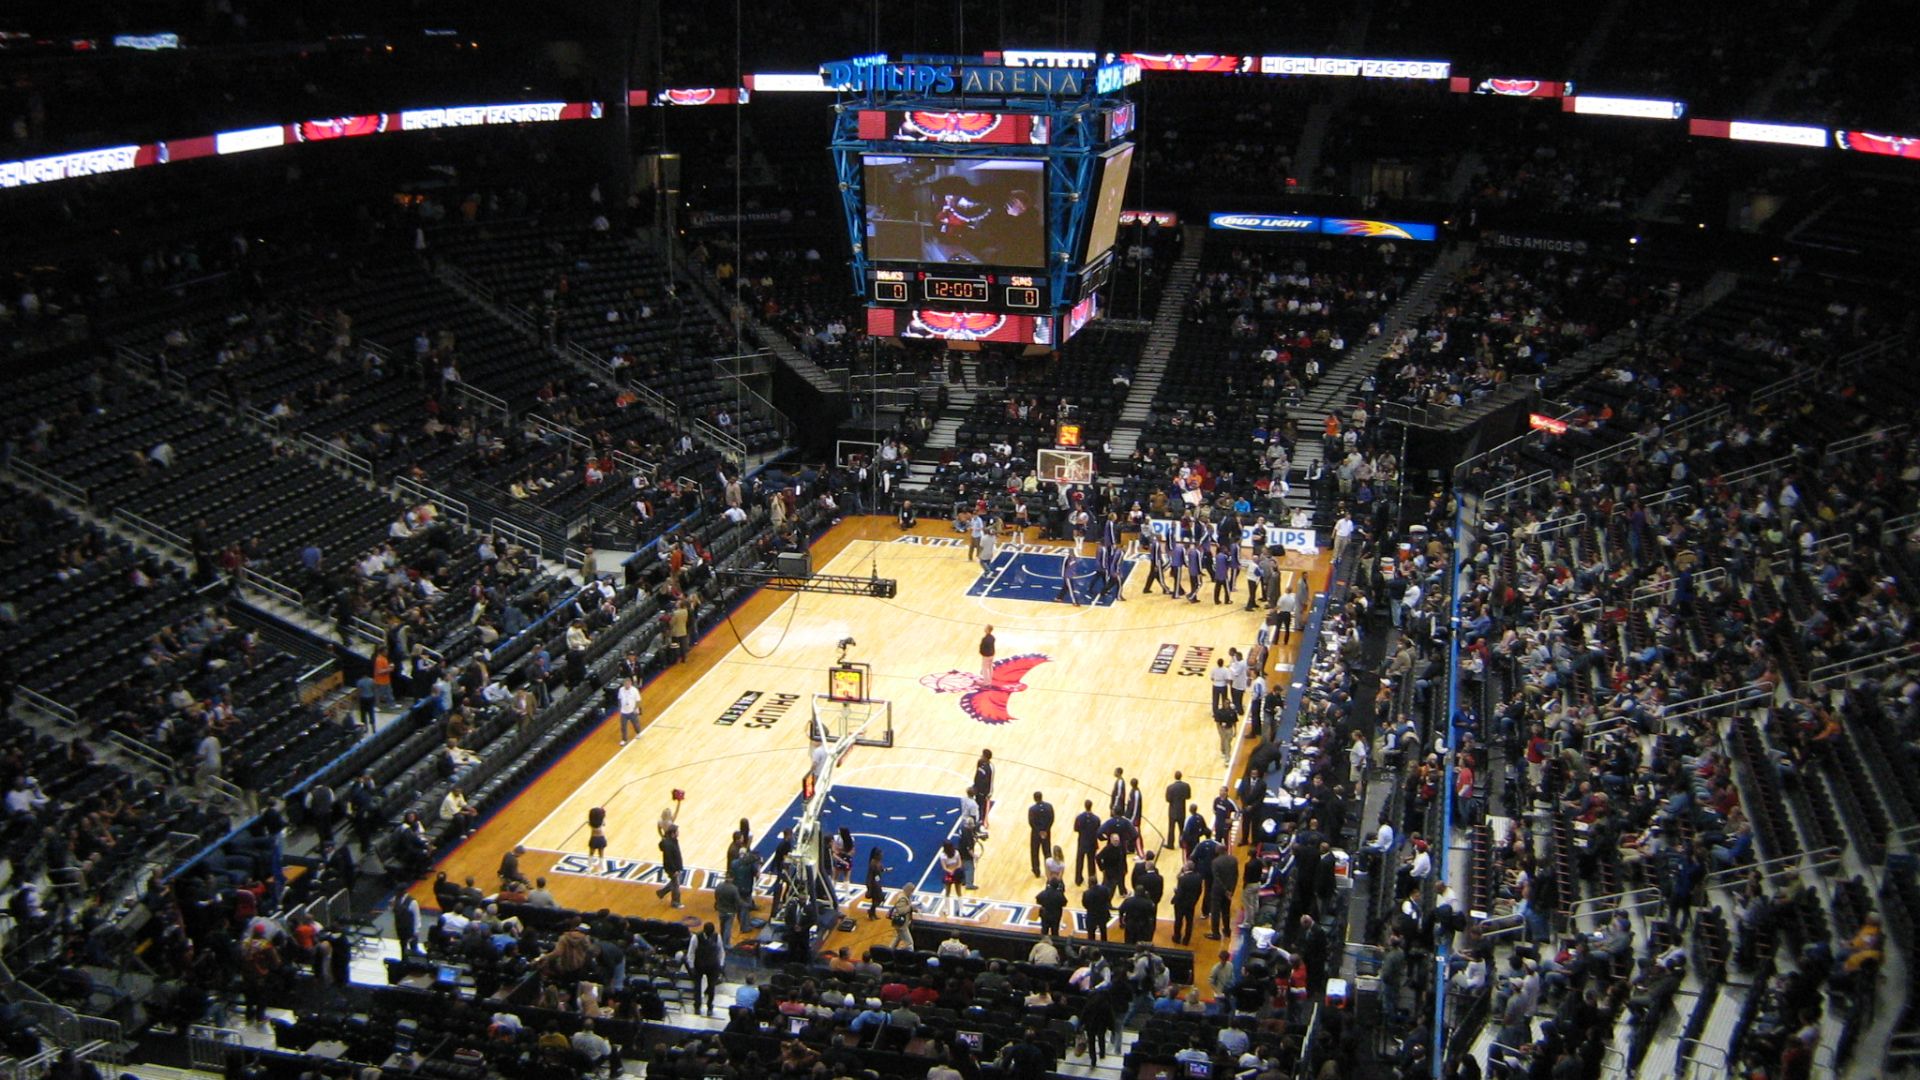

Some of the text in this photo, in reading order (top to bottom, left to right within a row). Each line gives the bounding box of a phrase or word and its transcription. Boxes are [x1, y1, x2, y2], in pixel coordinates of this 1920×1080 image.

[1264, 59, 1443, 78] HIGHLIGHT FACTORY
[831, 62, 954, 92] PHILIPS
[966, 69, 1079, 94] ARENA
[403, 104, 561, 130] HIGHLIGHT FACTORY
[67, 149, 134, 179] FACTORY
[1225, 217, 1312, 228] BUD LIGHT
[1523, 237, 1573, 253] AMIGOS
[934, 282, 973, 298] 12:00
[1011, 276, 1032, 287] SUNS
[893, 284, 903, 298] 0
[1025, 290, 1034, 305] 0
[890, 535, 1082, 557] ATLNTA
[1242, 529, 1306, 546] PLIPS
[1178, 645, 1215, 677] PHILIPS
[743, 692, 801, 729] PHILIPS
